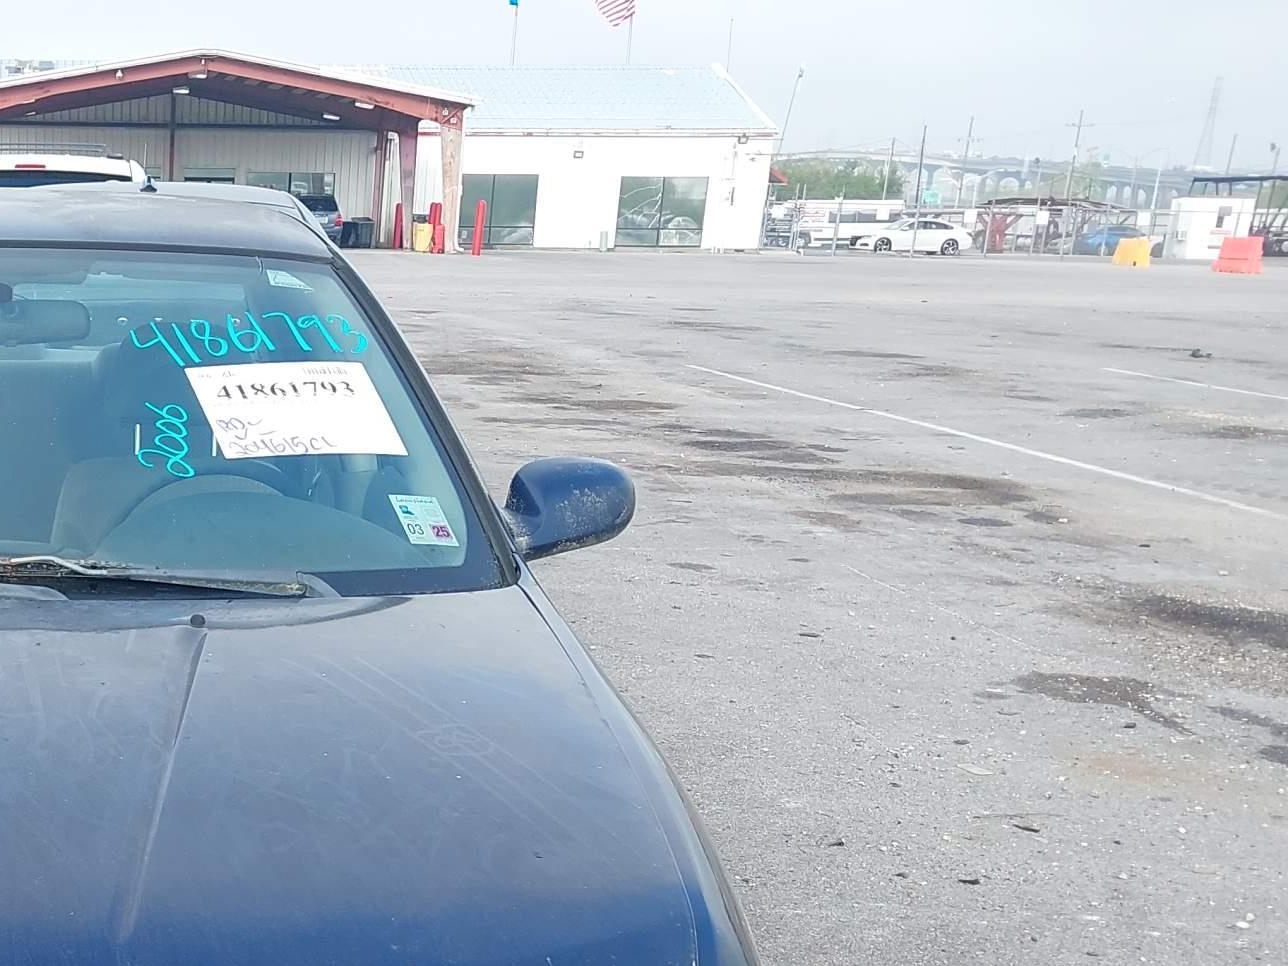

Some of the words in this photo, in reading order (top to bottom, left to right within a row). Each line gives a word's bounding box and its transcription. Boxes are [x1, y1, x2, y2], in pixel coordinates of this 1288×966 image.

[129, 311, 368, 367] 41861793
[216, 381, 355, 400] 41861793
[137, 402, 196, 478] 2006
[407, 523, 425, 535] 03
[432, 525, 451, 538] 25
